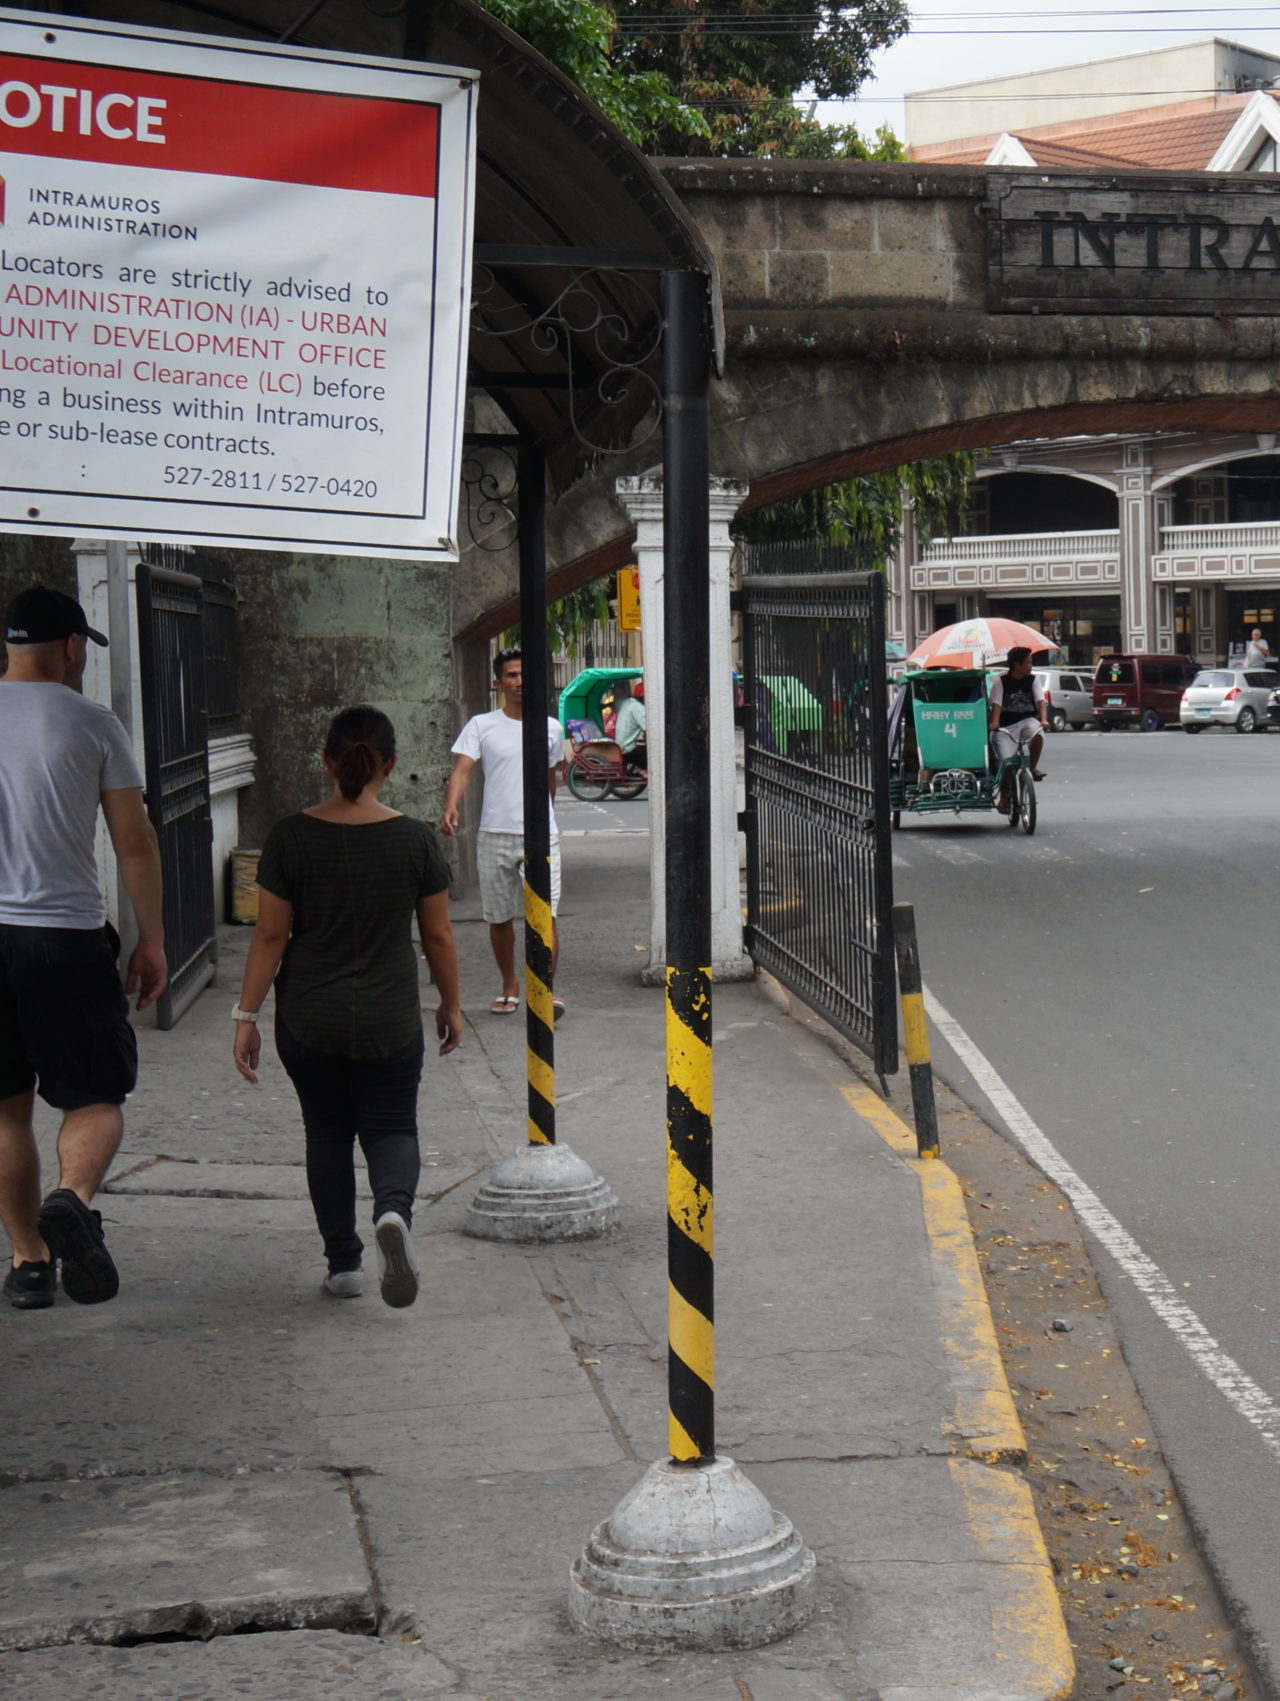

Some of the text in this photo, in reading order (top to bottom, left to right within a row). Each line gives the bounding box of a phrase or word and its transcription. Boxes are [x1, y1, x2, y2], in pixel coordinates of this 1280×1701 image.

[0, 80, 167, 144] OTICE
[29, 187, 161, 214] INTRAMUROS
[28, 210, 198, 240] ADMINISTRATION
[1, 249, 389, 306] Locators are strictly advised to
[5, 283, 233, 324] ADMINISTRATION
[240, 304, 280, 332] (IA)
[301, 310, 387, 338] URBAN
[0, 315, 387, 370] UNITY DEVELOPMENT OFFICE
[1, 349, 386, 401] Locational Clearance (LC) before
[37, 389, 50, 406] a
[62, 386, 162, 415] business
[172, 397, 244, 422] within
[256, 402, 385, 435] Intramuros,
[16, 420, 43, 438] or
[48, 419, 158, 447] sub-lease
[163, 431, 276, 456] contracts.
[163, 465, 263, 490] 527-2811
[280, 474, 378, 499] 527-0420
[944, 722, 957, 738] 4
[940, 778, 971, 795] ROSE
